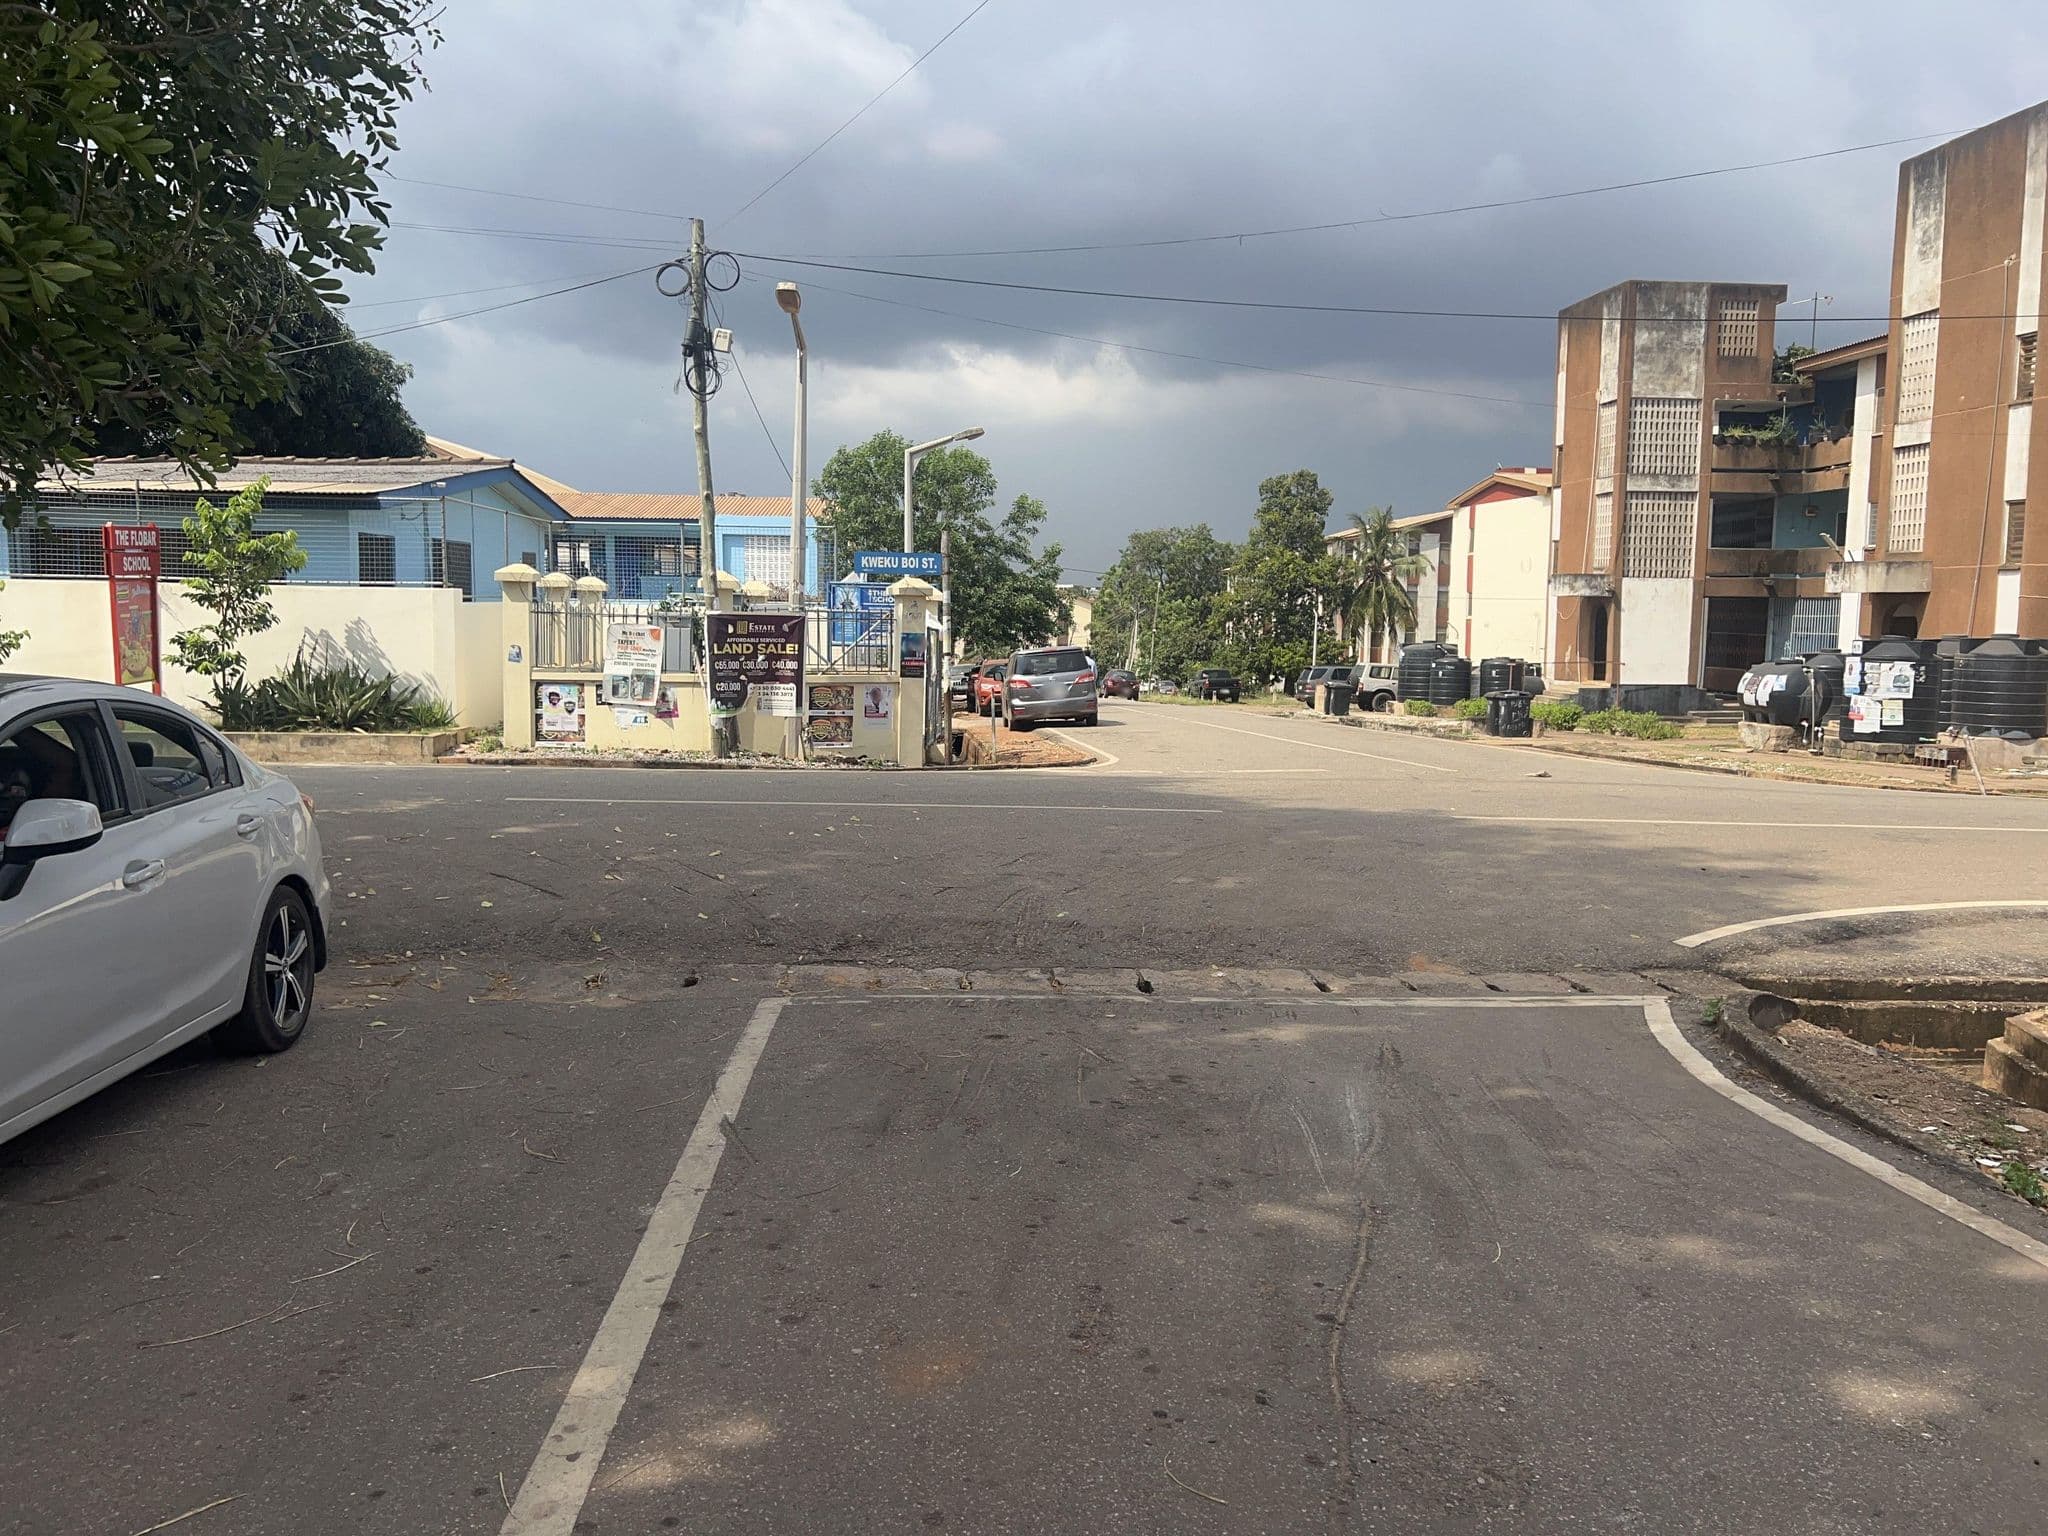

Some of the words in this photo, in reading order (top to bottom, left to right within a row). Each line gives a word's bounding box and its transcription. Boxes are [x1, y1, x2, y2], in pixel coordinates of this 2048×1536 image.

[115, 530, 129, 545] THE
[131, 531, 156, 546] FLOBAR
[123, 556, 151, 571] SCHOOL
[861, 557, 898, 568] KWEKU
[902, 557, 918, 568] BOI
[922, 558, 937, 568] ST.
[713, 644, 753, 654] LAND
[757, 644, 798, 654] SALE!
